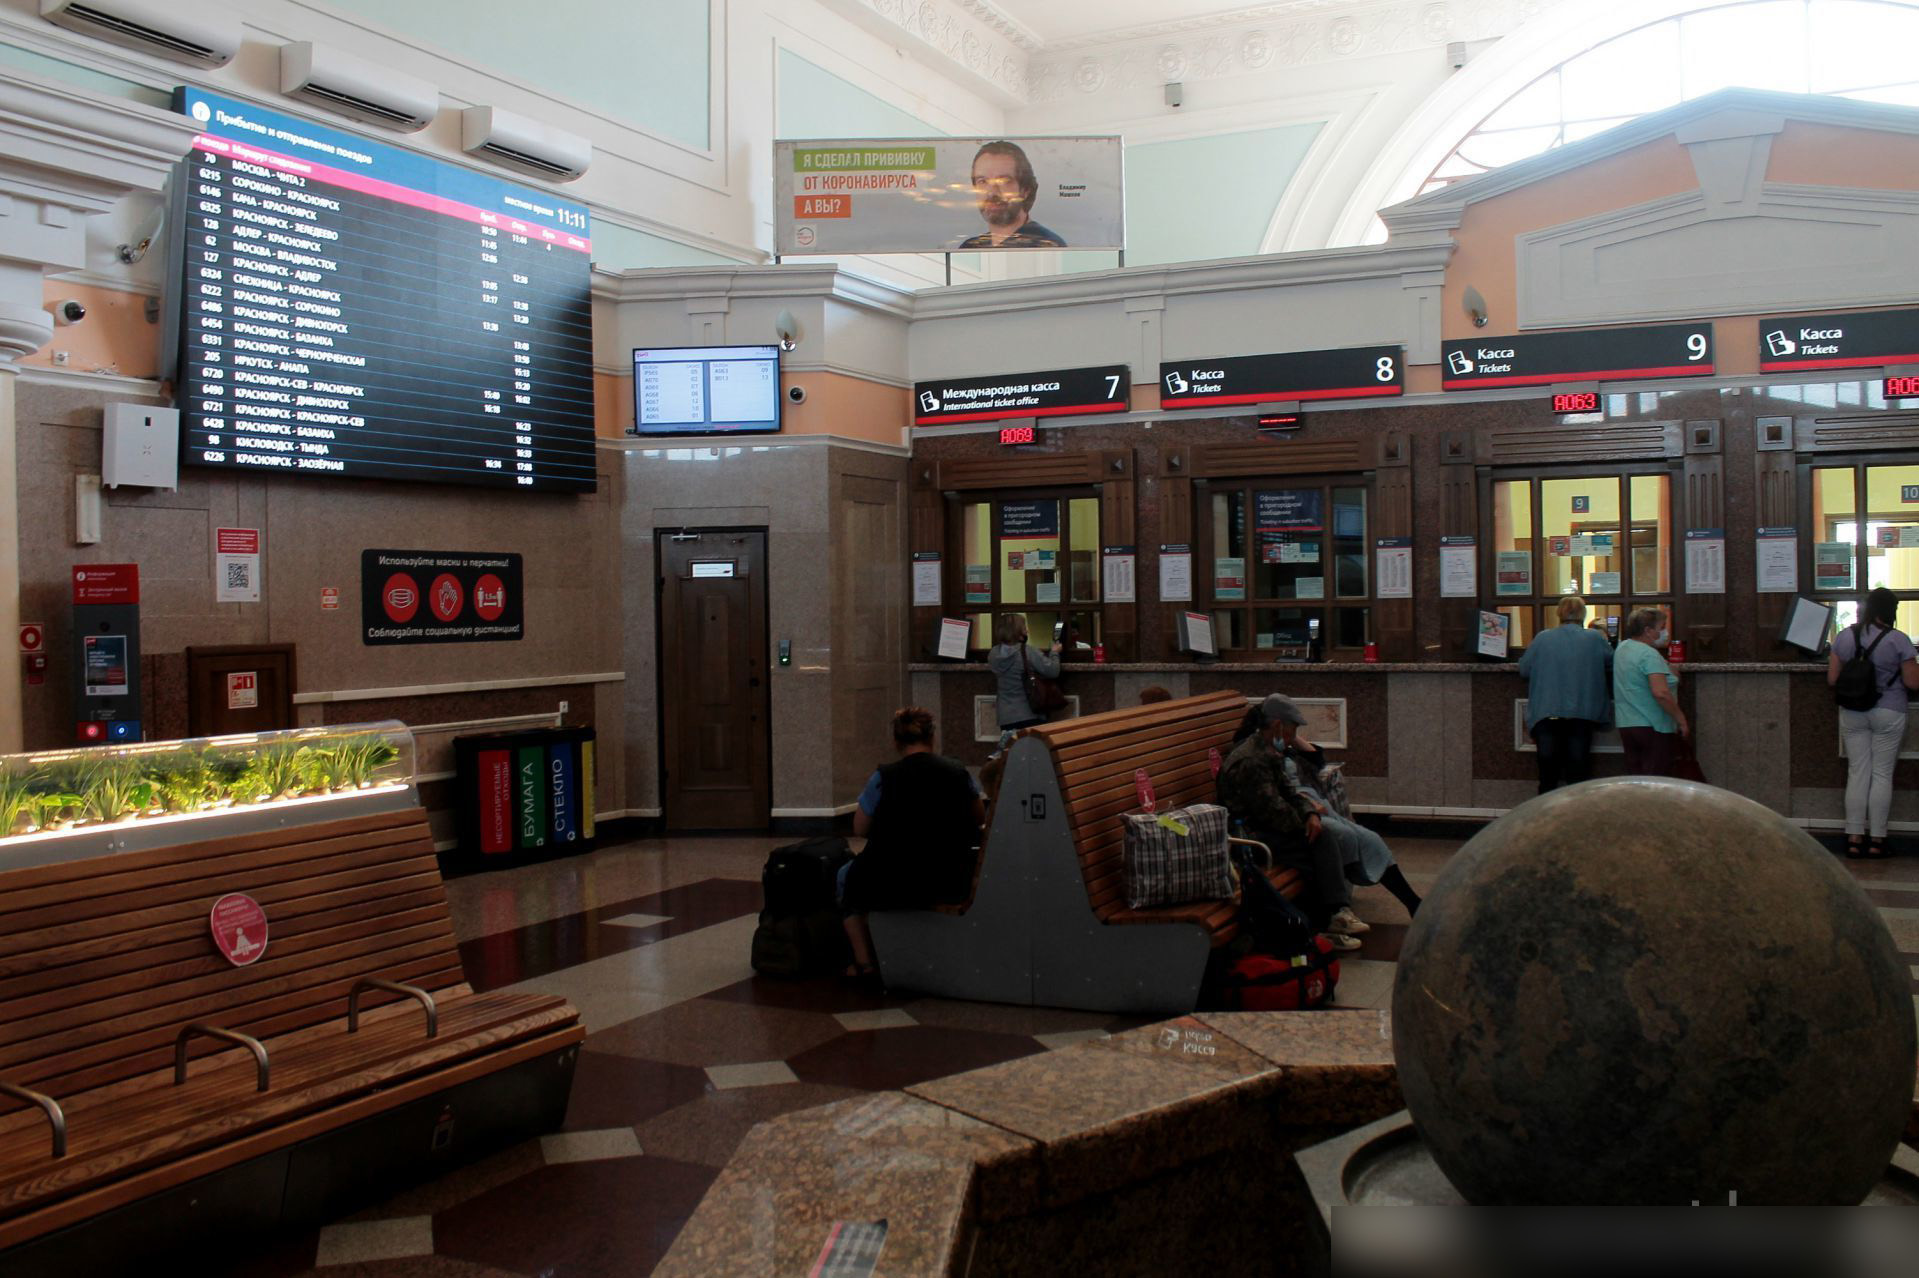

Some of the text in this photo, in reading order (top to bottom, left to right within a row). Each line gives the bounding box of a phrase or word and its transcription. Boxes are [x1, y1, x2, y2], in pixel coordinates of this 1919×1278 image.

[216, 110, 373, 164] Прибытие и отправление поездов
[803, 151, 926, 169] Я СДЕЛАЛ ПРИВИВКУ
[205, 153, 216, 163] 70
[232, 160, 271, 178] МОСКВА
[275, 172, 300, 185] ЧИТА
[300, 178, 305, 187] 2
[199, 168, 221, 181] 6215
[232, 176, 281, 196] СОРОКИНО
[287, 190, 339, 210] КРАСНОЯРСК
[803, 174, 918, 190] ОТ КОРОНАВИРУСА
[200, 201, 221, 214] 6325
[232, 208, 288, 229] КРАСНОЯРСК
[262, 200, 317, 220] КРАСНОЯРСК
[803, 199, 841, 214] А ВЫ?
[558, 208, 585, 228] 11:11
[233, 225, 262, 238] АДЛЕР
[267, 232, 321, 252] КРАСНОЯРСК
[205, 235, 216, 246] 62
[233, 241, 271, 257] МОСКВА
[277, 250, 336, 271] ВЛАДИВОСТОК
[203, 251, 219, 262] 127
[233, 257, 289, 276] КРАСНОЯРСК
[295, 270, 321, 282] АДЛЕР
[200, 284, 340, 317] 6222 КРАСНОЯРСК СОРОКИНО
[288, 284, 340, 302] КРАСНОЯРСК
[233, 306, 289, 324] КРАСНОЯРСК
[294, 317, 347, 333] ДИВНОГОРСК
[234, 322, 289, 339] КРАСНОЯРСК
[1800, 328, 1843, 340] Касса
[234, 339, 290, 355] КРАСНОЯРСК
[1477, 348, 1515, 360] Касса
[1687, 333, 1707, 361] 9
[1801, 344, 1839, 355] Tickets
[204, 351, 220, 362] 205
[234, 355, 273, 369] ИРКУТСК
[279, 362, 309, 374] АНАПА
[1376, 357, 1395, 382] 8
[1478, 363, 1511, 374] Tickets
[234, 370, 308, 389] КРАСНОЯРСК-СЕВ
[313, 382, 364, 396] КРАСНОЯРСК
[1191, 369, 1225, 381] Касса
[943, 381, 1060, 400] Международная касса
[1105, 375, 1120, 399] 7
[1192, 383, 1221, 394] Tickets
[235, 388, 290, 403] КРАСНОЯРСК
[295, 395, 349, 410] ДИВНОГОРСК
[943, 396, 1039, 412] International ticket office
[203, 401, 223, 412] 6721
[235, 404, 291, 419] КРАСНОЯРСК
[296, 411, 364, 427] КРАСНОЯРСК-СЕВ
[235, 420, 291, 435] КРАСНОЯРСК
[236, 437, 294, 452] КИСЛОВОДСК
[300, 443, 329, 455] ТЫНДА
[204, 451, 225, 462] 6226
[236, 453, 292, 467] КРАСНОЯРСК
[1904, 487, 1918, 498] 10
[1576, 498, 1583, 510] 9
[379, 556, 434, 568] Используйте
[437, 559, 461, 567] маски
[470, 558, 510, 568] перчатки!
[368, 624, 520, 639] Соблюдайте социальную дистанцию!
[522, 762, 535, 837] БУМАГА
[552, 759, 566, 832] СТЕКЛО
